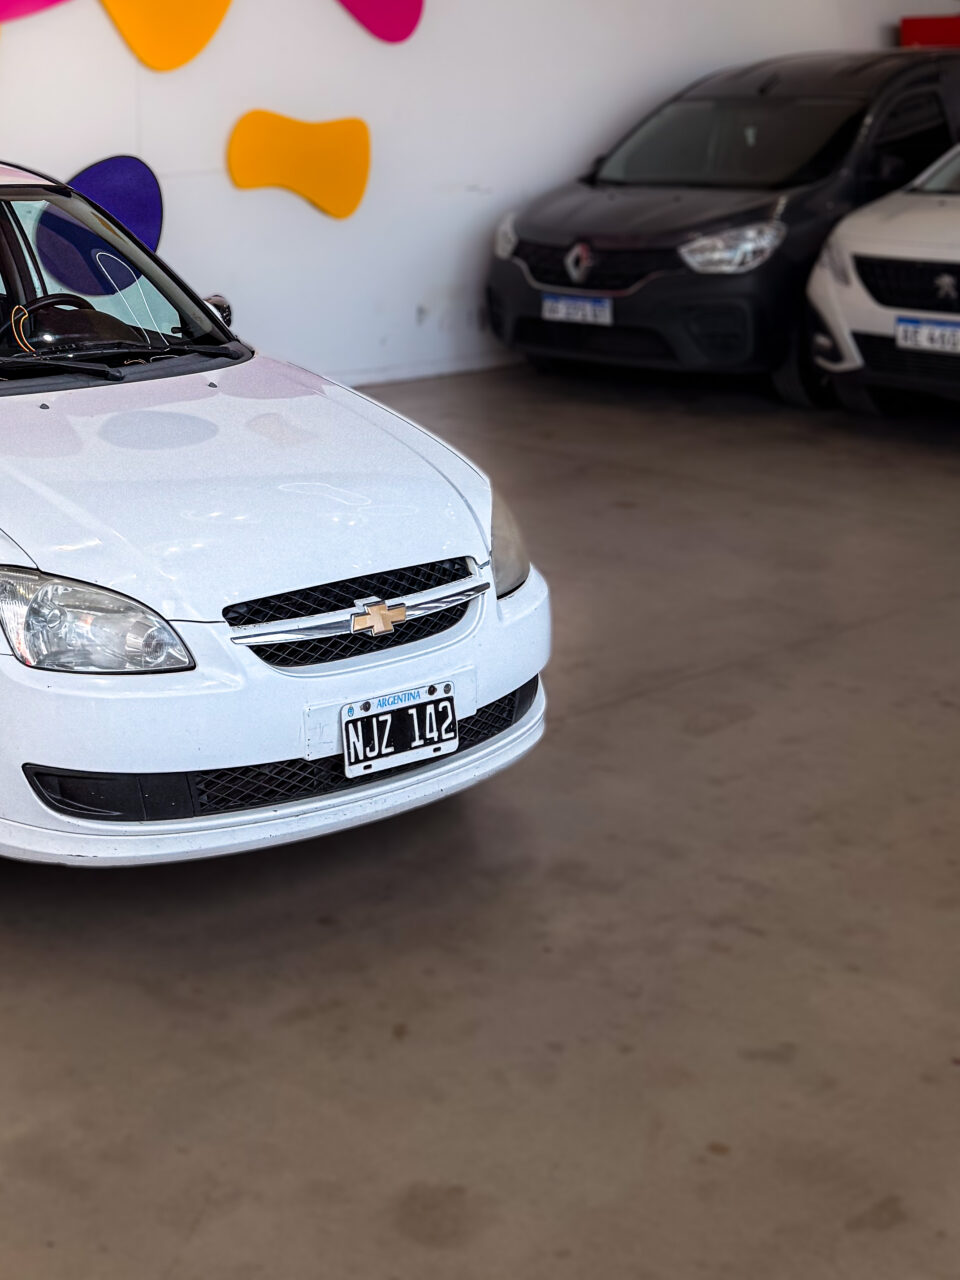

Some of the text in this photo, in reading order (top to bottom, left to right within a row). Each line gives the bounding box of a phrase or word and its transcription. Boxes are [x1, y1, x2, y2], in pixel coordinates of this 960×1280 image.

[376, 690, 421, 709] ARGENTINA
[348, 700, 455, 763] NJZ 142
